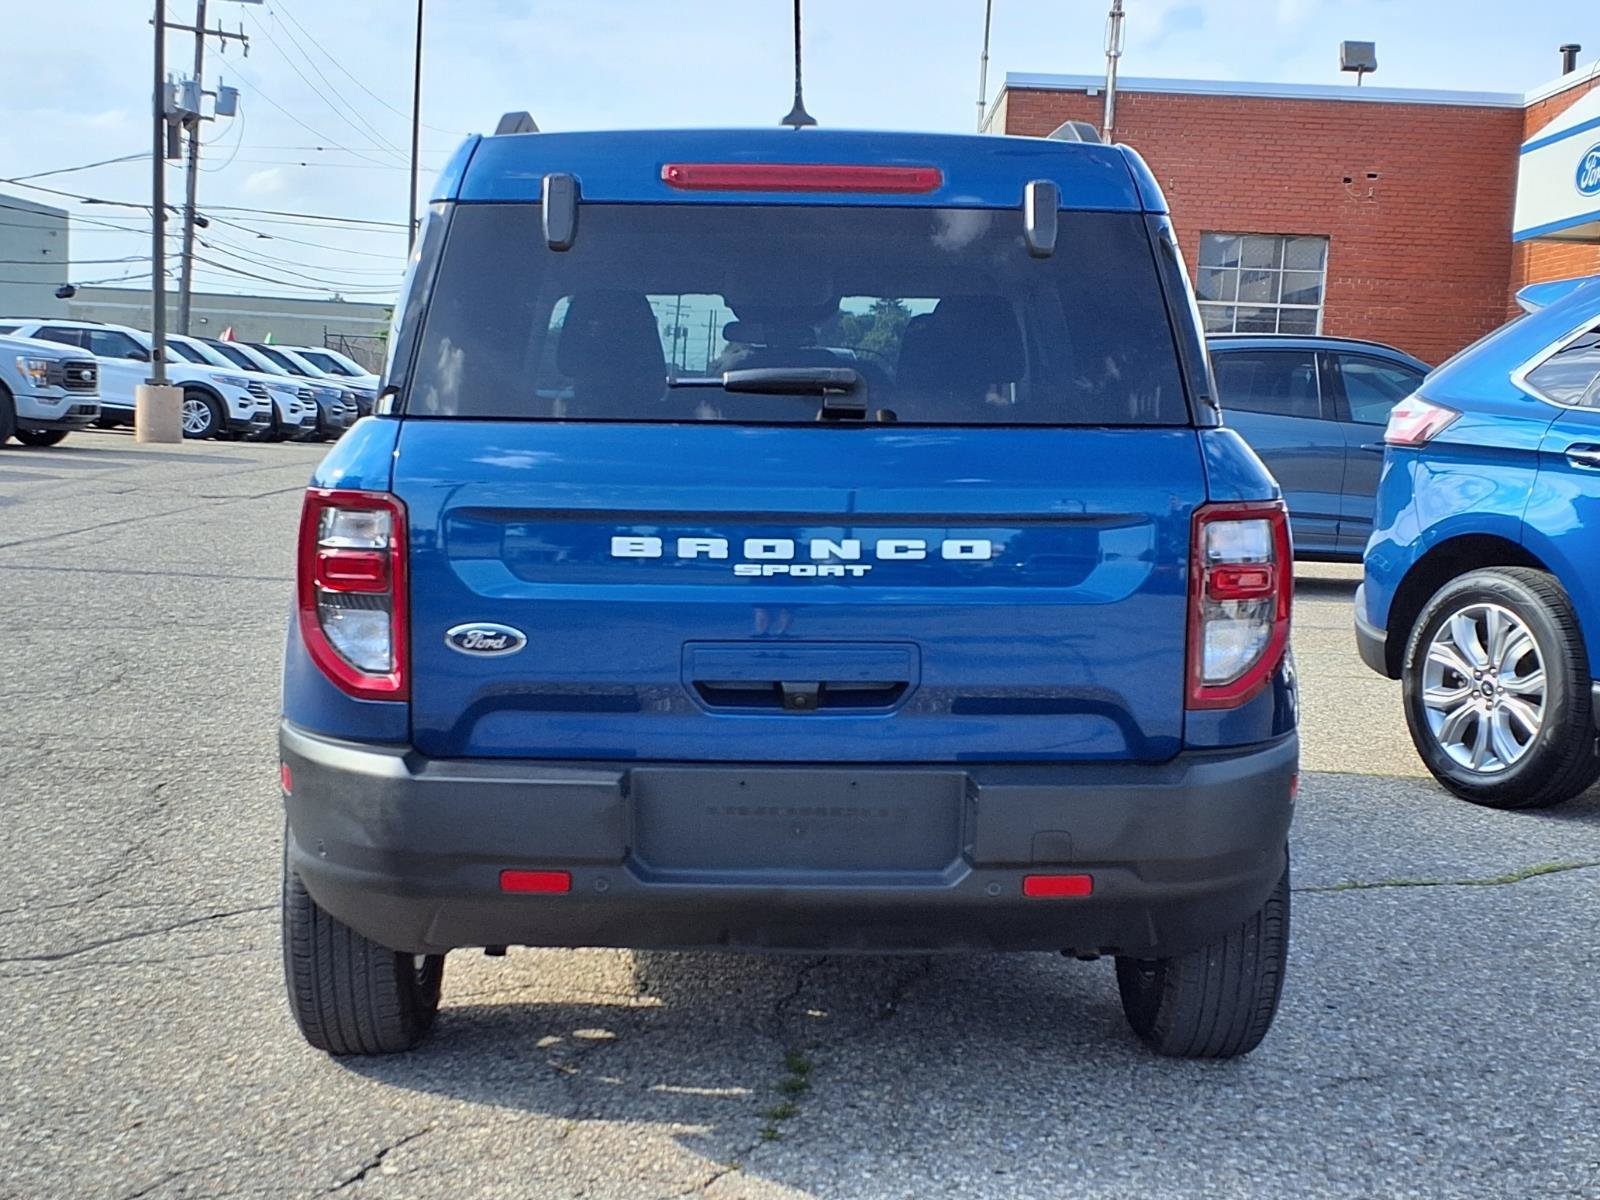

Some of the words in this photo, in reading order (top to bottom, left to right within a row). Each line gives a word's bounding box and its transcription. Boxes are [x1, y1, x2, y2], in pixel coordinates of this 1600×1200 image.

[1581, 151, 1600, 189] For
[611, 536, 992, 560] BRONCO
[733, 564, 872, 577] SPORT
[463, 630, 507, 648] Ford
